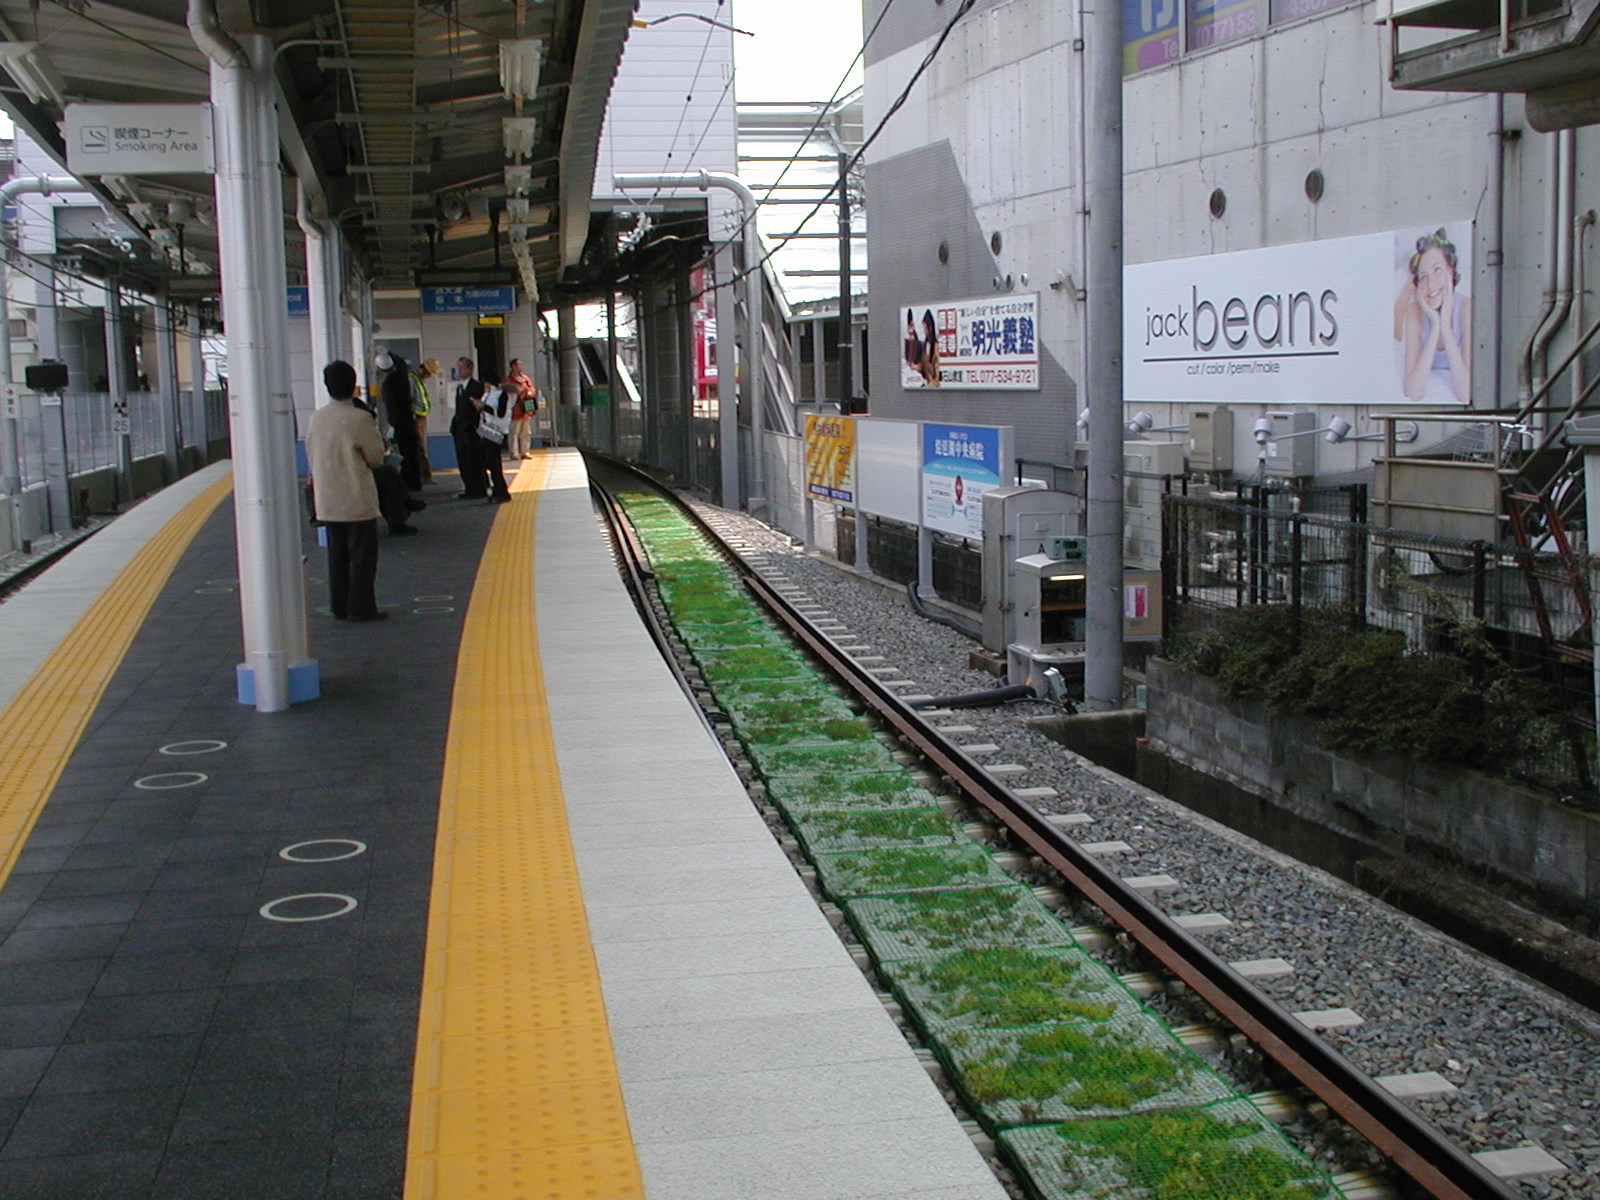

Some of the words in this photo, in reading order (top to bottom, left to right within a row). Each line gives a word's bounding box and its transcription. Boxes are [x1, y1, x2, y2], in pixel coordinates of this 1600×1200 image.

[114, 127, 189, 139] 喫煙コーナー
[115, 142, 167, 153] Smoking
[170, 141, 198, 151] Area
[1145, 304, 1189, 346] jack
[1192, 284, 1339, 352] beans
[972, 316, 1035, 356] 明光義塾
[114, 420, 128, 432] 25
